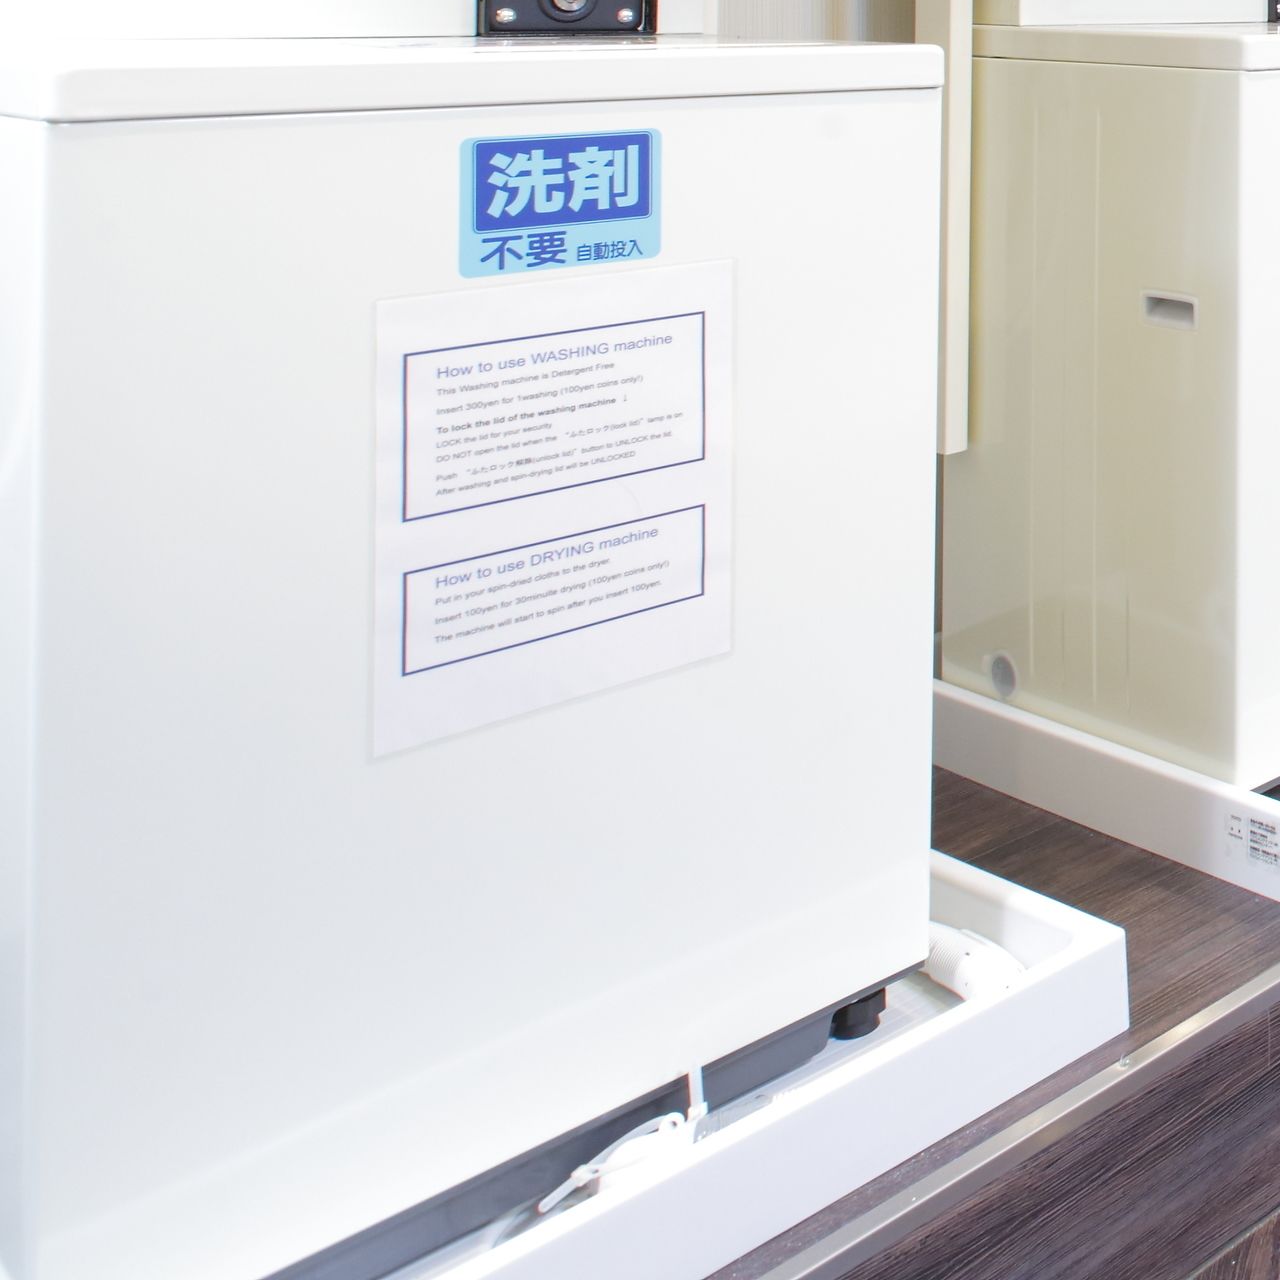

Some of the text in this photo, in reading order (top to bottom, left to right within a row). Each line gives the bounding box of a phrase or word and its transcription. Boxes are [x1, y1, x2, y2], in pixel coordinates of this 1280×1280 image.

[486, 144, 640, 219] 洗剤
[480, 230, 643, 270] 不要 自動投入
[437, 335, 673, 379] How to use WASHING machine
[437, 387, 456, 396] This
[459, 380, 499, 393] Washing
[501, 372, 539, 386] machine
[551, 365, 593, 379] Detergent
[437, 397, 616, 435] To lock the lid of the washing machine
[435, 528, 659, 589] How to use DRYING machine
